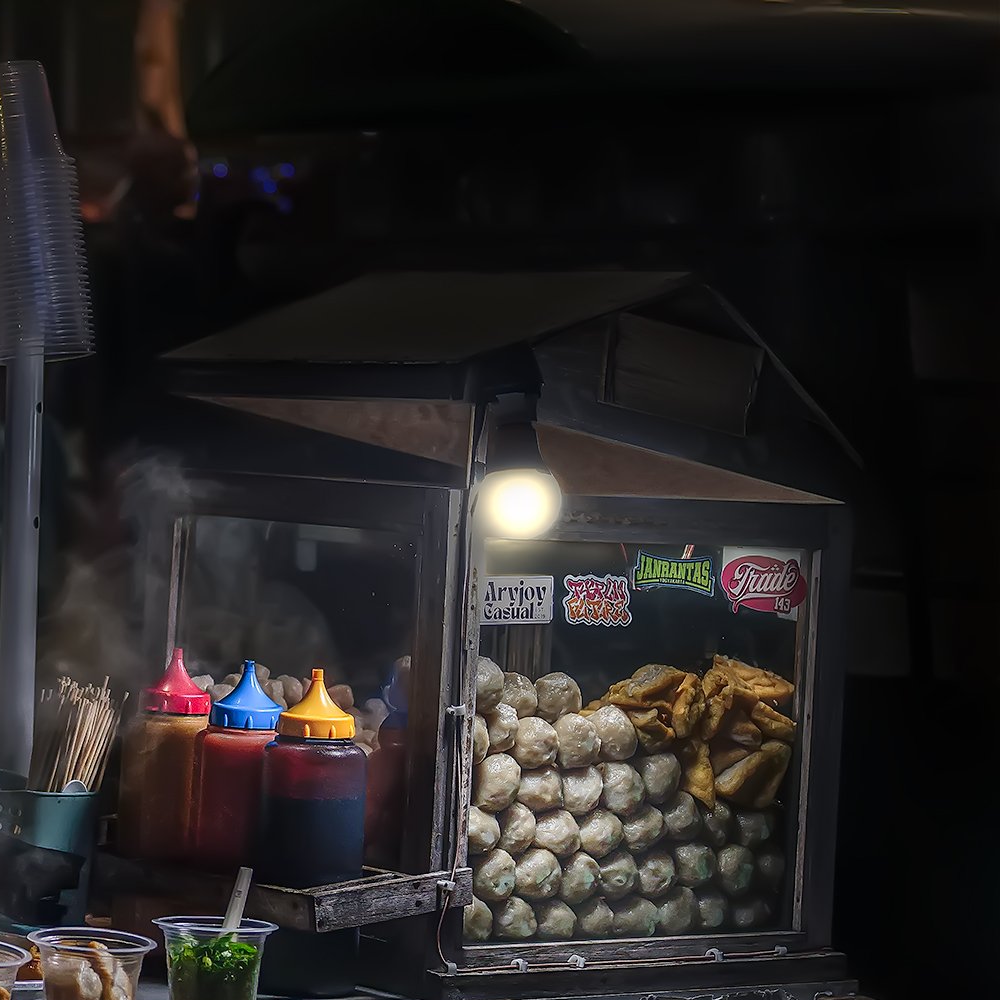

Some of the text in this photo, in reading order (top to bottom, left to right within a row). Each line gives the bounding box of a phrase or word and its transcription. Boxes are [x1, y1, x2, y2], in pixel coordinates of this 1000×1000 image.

[484, 580, 547, 607] Aryjoy
[484, 602, 535, 620] Casual
[773, 596, 791, 612] 143
